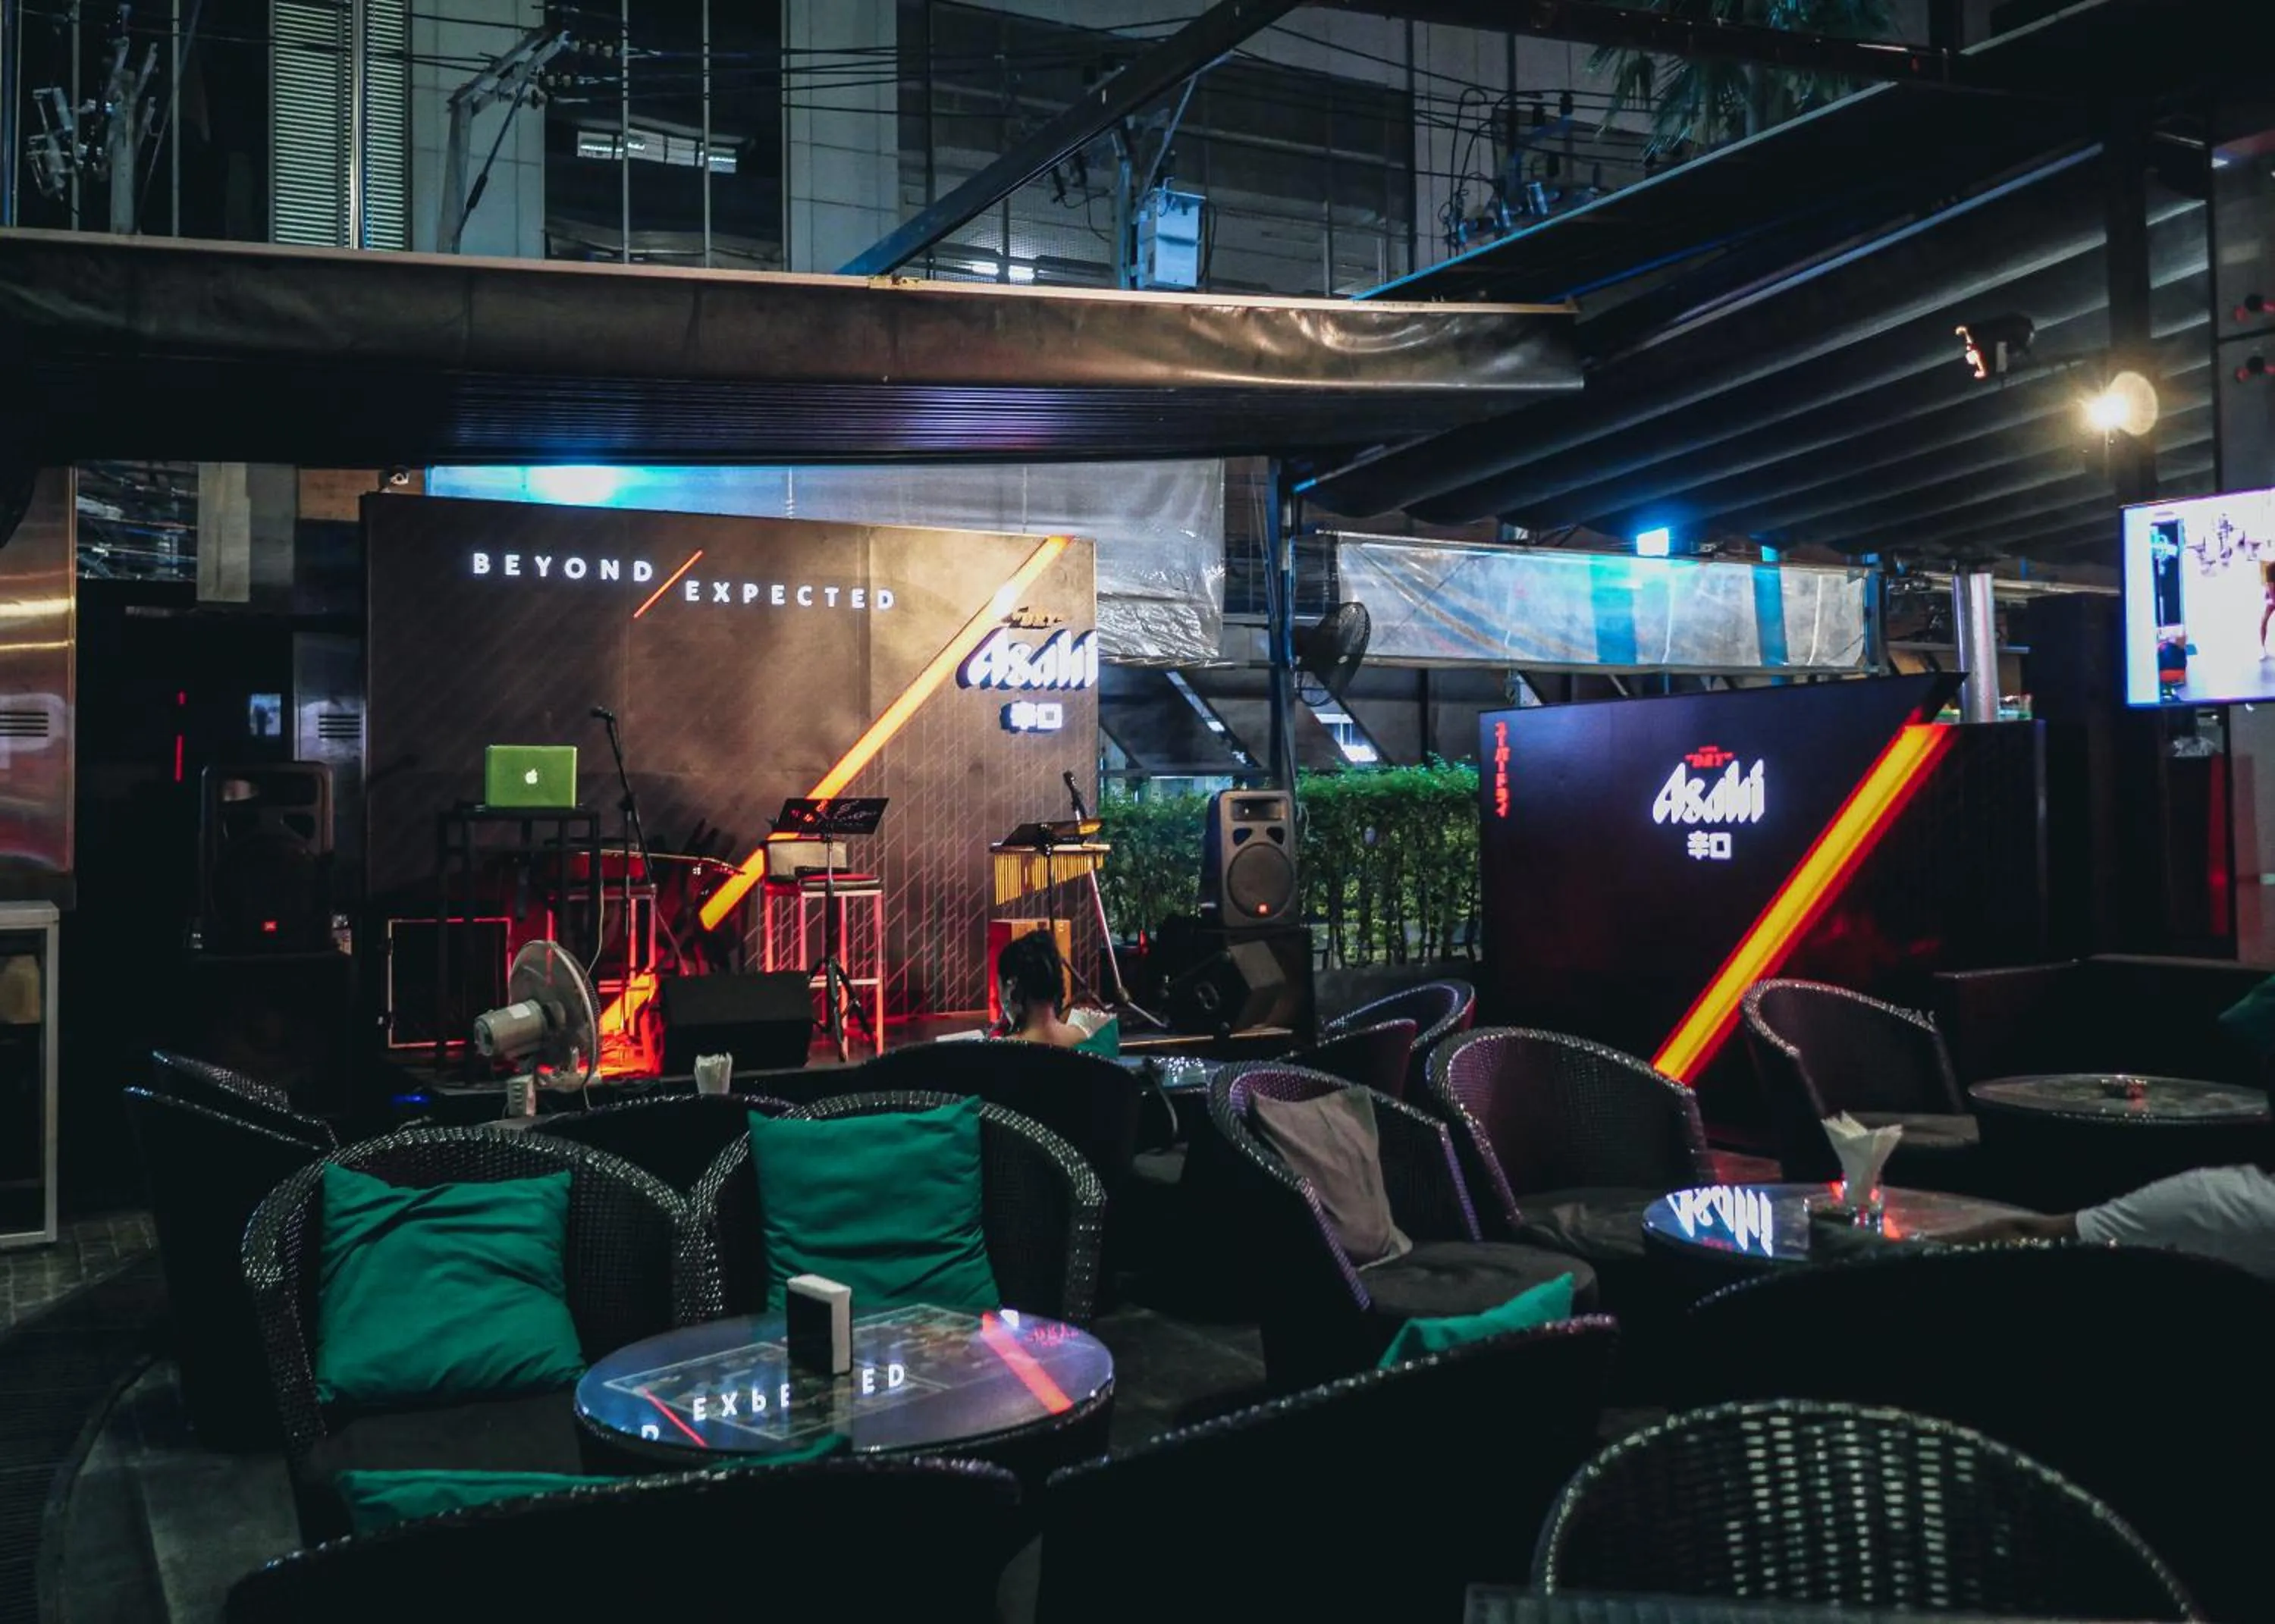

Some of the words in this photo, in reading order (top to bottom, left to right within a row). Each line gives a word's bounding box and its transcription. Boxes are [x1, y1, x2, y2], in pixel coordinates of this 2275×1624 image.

[472, 552, 654, 582] BEYOND
[685, 579, 895, 610] EXPECTED
[956, 626, 1098, 689] Asahi
[1652, 759, 1765, 824] Asahi
